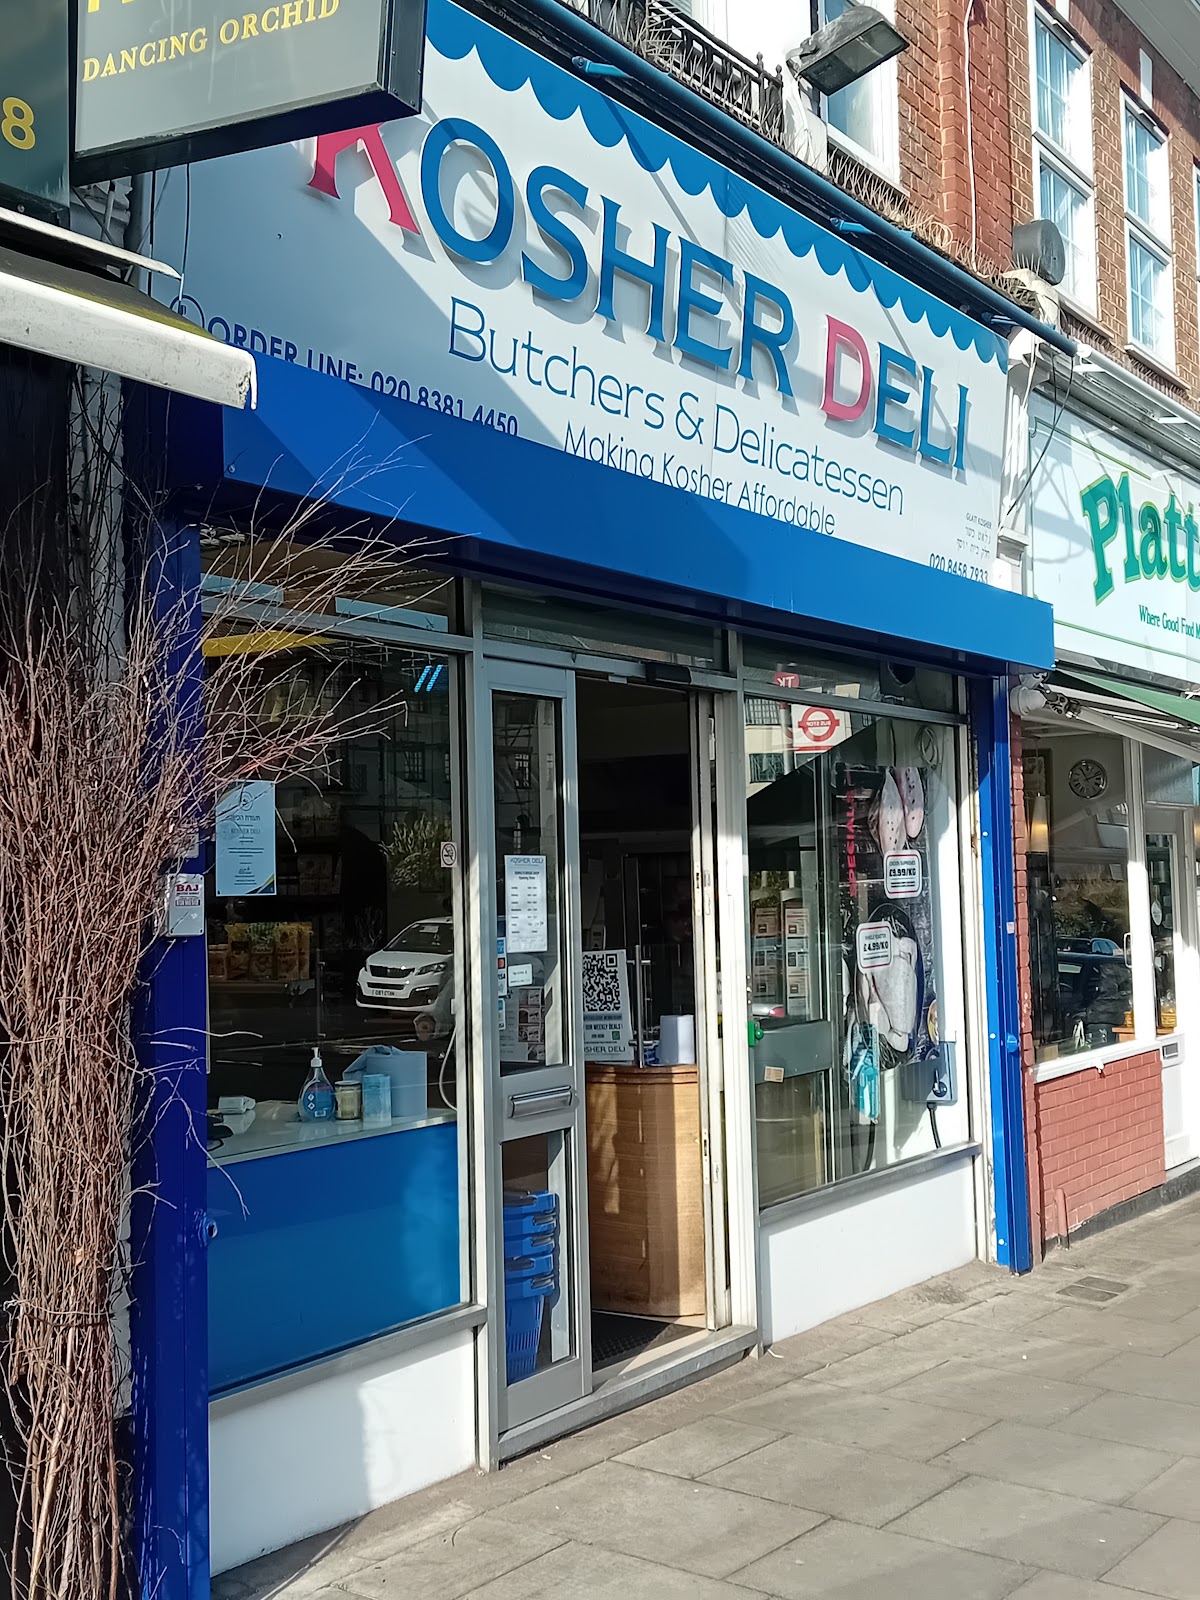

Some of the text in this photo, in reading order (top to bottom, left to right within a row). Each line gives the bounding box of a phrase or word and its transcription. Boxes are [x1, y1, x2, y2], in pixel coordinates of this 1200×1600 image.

[81, 0, 340, 82] DANCING ORCHID
[1, 96, 36, 150] 8
[370, 371, 411, 402] 020
[417, 386, 465, 419] 8381
[448, 296, 904, 515] Butchers & Delicatessen
[819, 314, 969, 471] DELI
[563, 420, 836, 536] Making Kosher Affordable
[929, 552, 946, 571] 020
[947, 559, 968, 578] 8458
[1080, 471, 1200, 607] Platt
[1138, 604, 1160, 628] Where
[1161, 612, 1179, 633] Good
[1181, 618, 1195, 638] Food
[846, 790, 857, 897] SPECIALS
[176, 884, 199, 892] BAJ
